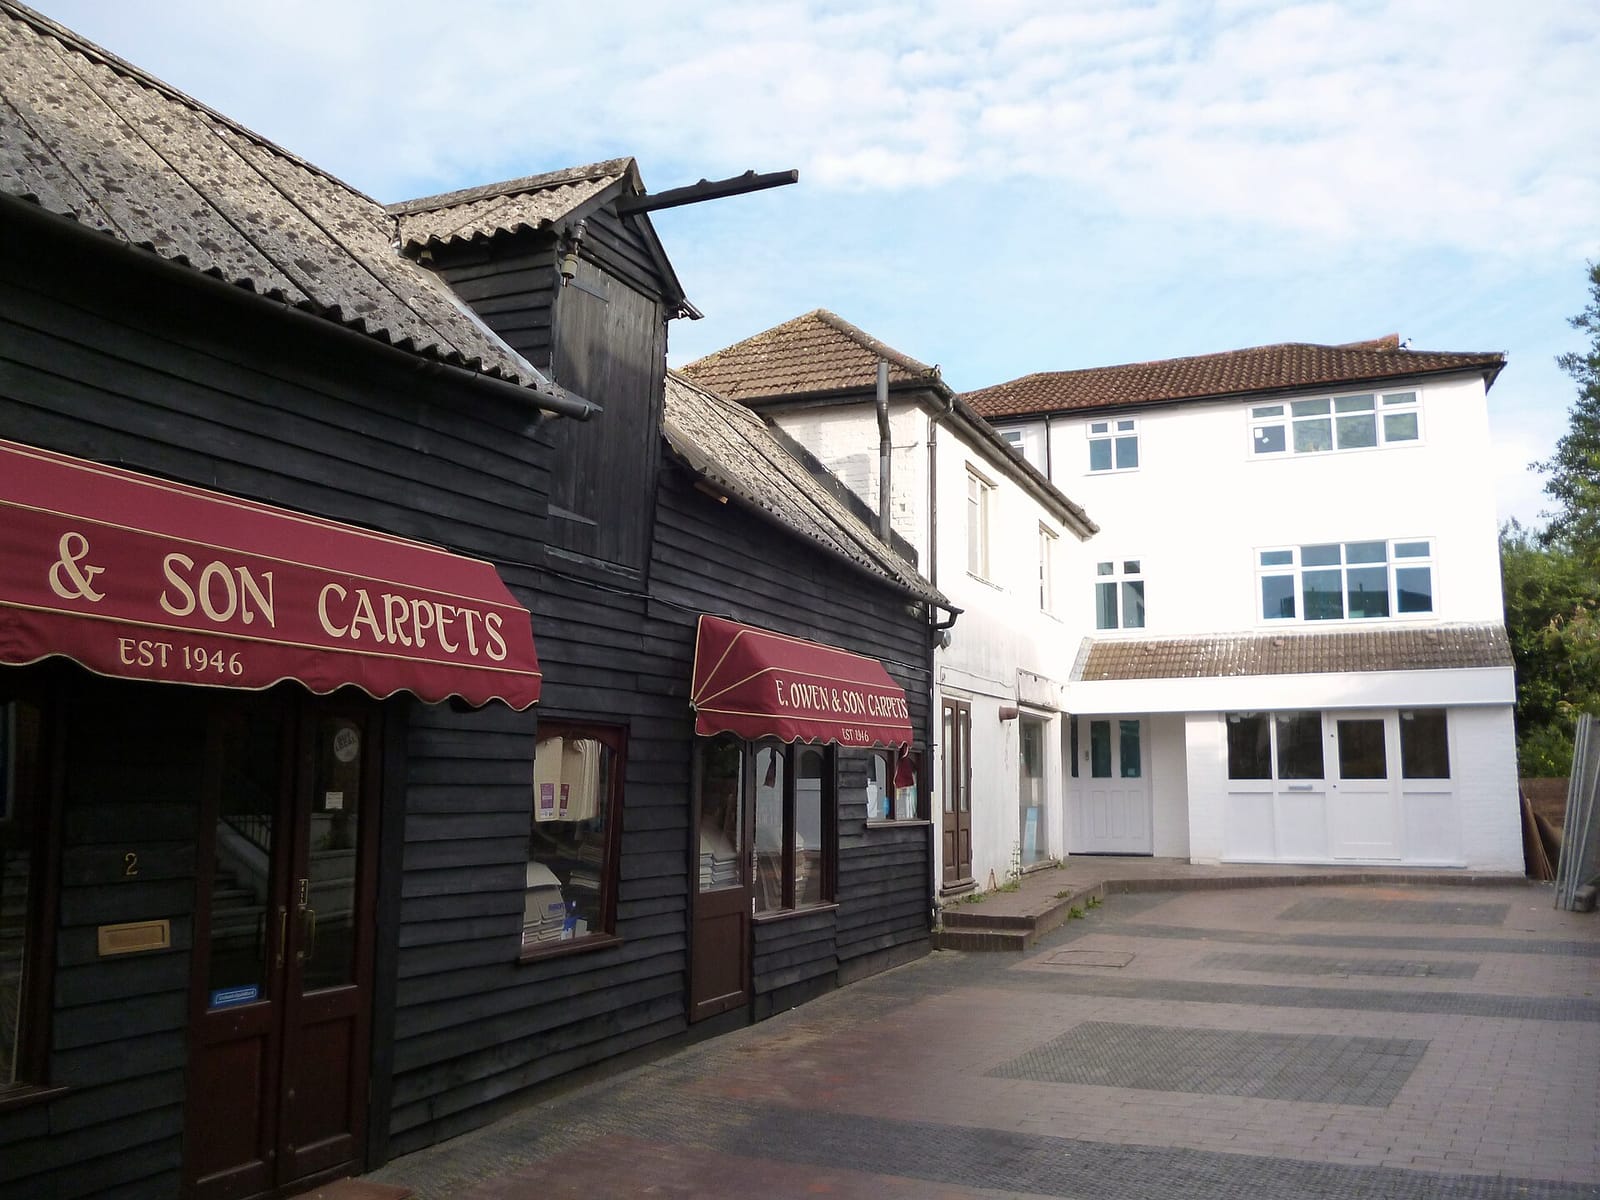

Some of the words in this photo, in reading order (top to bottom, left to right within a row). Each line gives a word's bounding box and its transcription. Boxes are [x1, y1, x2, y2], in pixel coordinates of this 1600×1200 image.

[49, 531, 106, 602] &
[159, 552, 276, 629] SON
[317, 583, 507, 661] CARPETS
[118, 637, 173, 668] EST
[183, 645, 244, 676] 1946
[775, 679, 789, 706] E.
[790, 682, 831, 711] OWEN
[831, 688, 842, 713] &
[842, 690, 866, 715] SON
[867, 694, 909, 719] CARPETS
[842, 728, 854, 741] EST
[125, 852, 139, 876] 2
